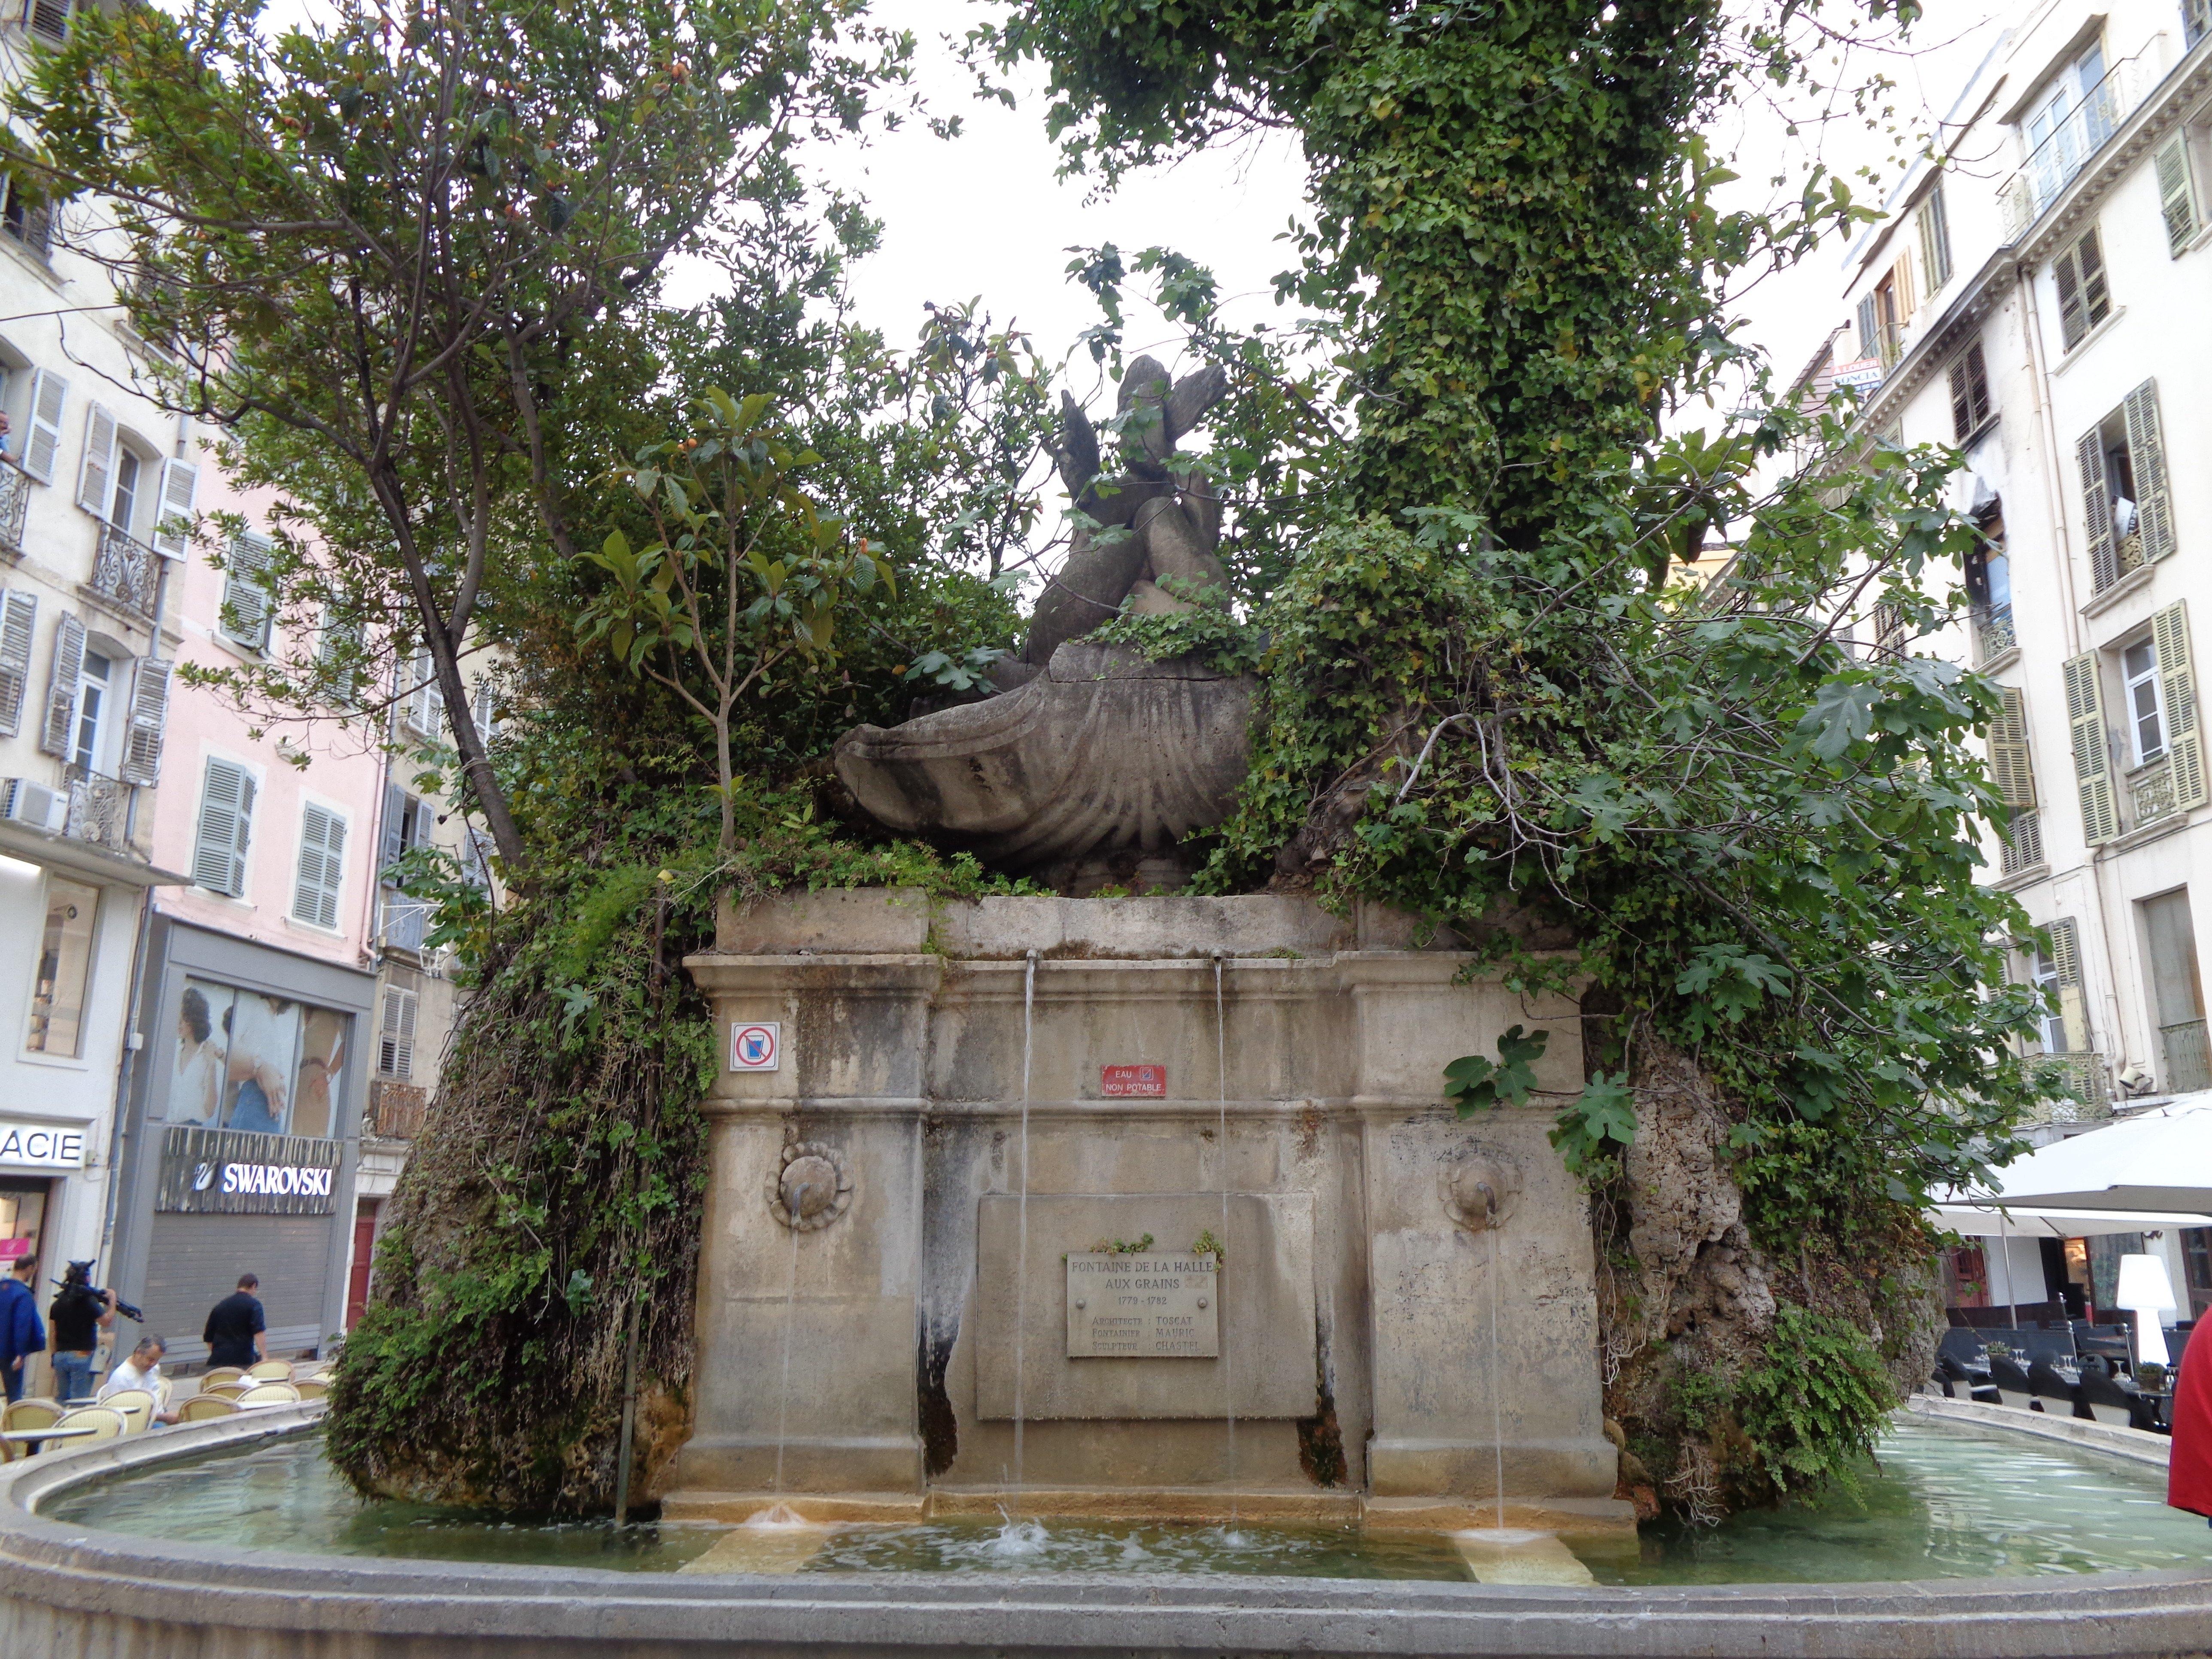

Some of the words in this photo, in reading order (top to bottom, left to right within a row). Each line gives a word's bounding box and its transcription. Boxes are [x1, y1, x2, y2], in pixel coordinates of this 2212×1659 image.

[1844, 359, 1877, 371] LOUER
[1115, 1070, 1132, 1079] EAU
[0, 1130, 82, 1161] ACIE
[222, 1163, 333, 1196] SWAROVSKI
[1072, 1262, 1131, 1273] FONTAINE
[1135, 1262, 1149, 1272] DE
[1154, 1262, 1169, 1272] LA
[1174, 1262, 1213, 1272] HALLE
[1106, 1279, 1130, 1288] AUX
[1135, 1279, 1179, 1288] GRAINS
[1147, 1296, 1167, 1305] 1782
[1155, 1316, 1193, 1325] TOSCAT
[1155, 1328, 1194, 1337] MAURIC
[1155, 1341, 1200, 1351] CHASTEL
